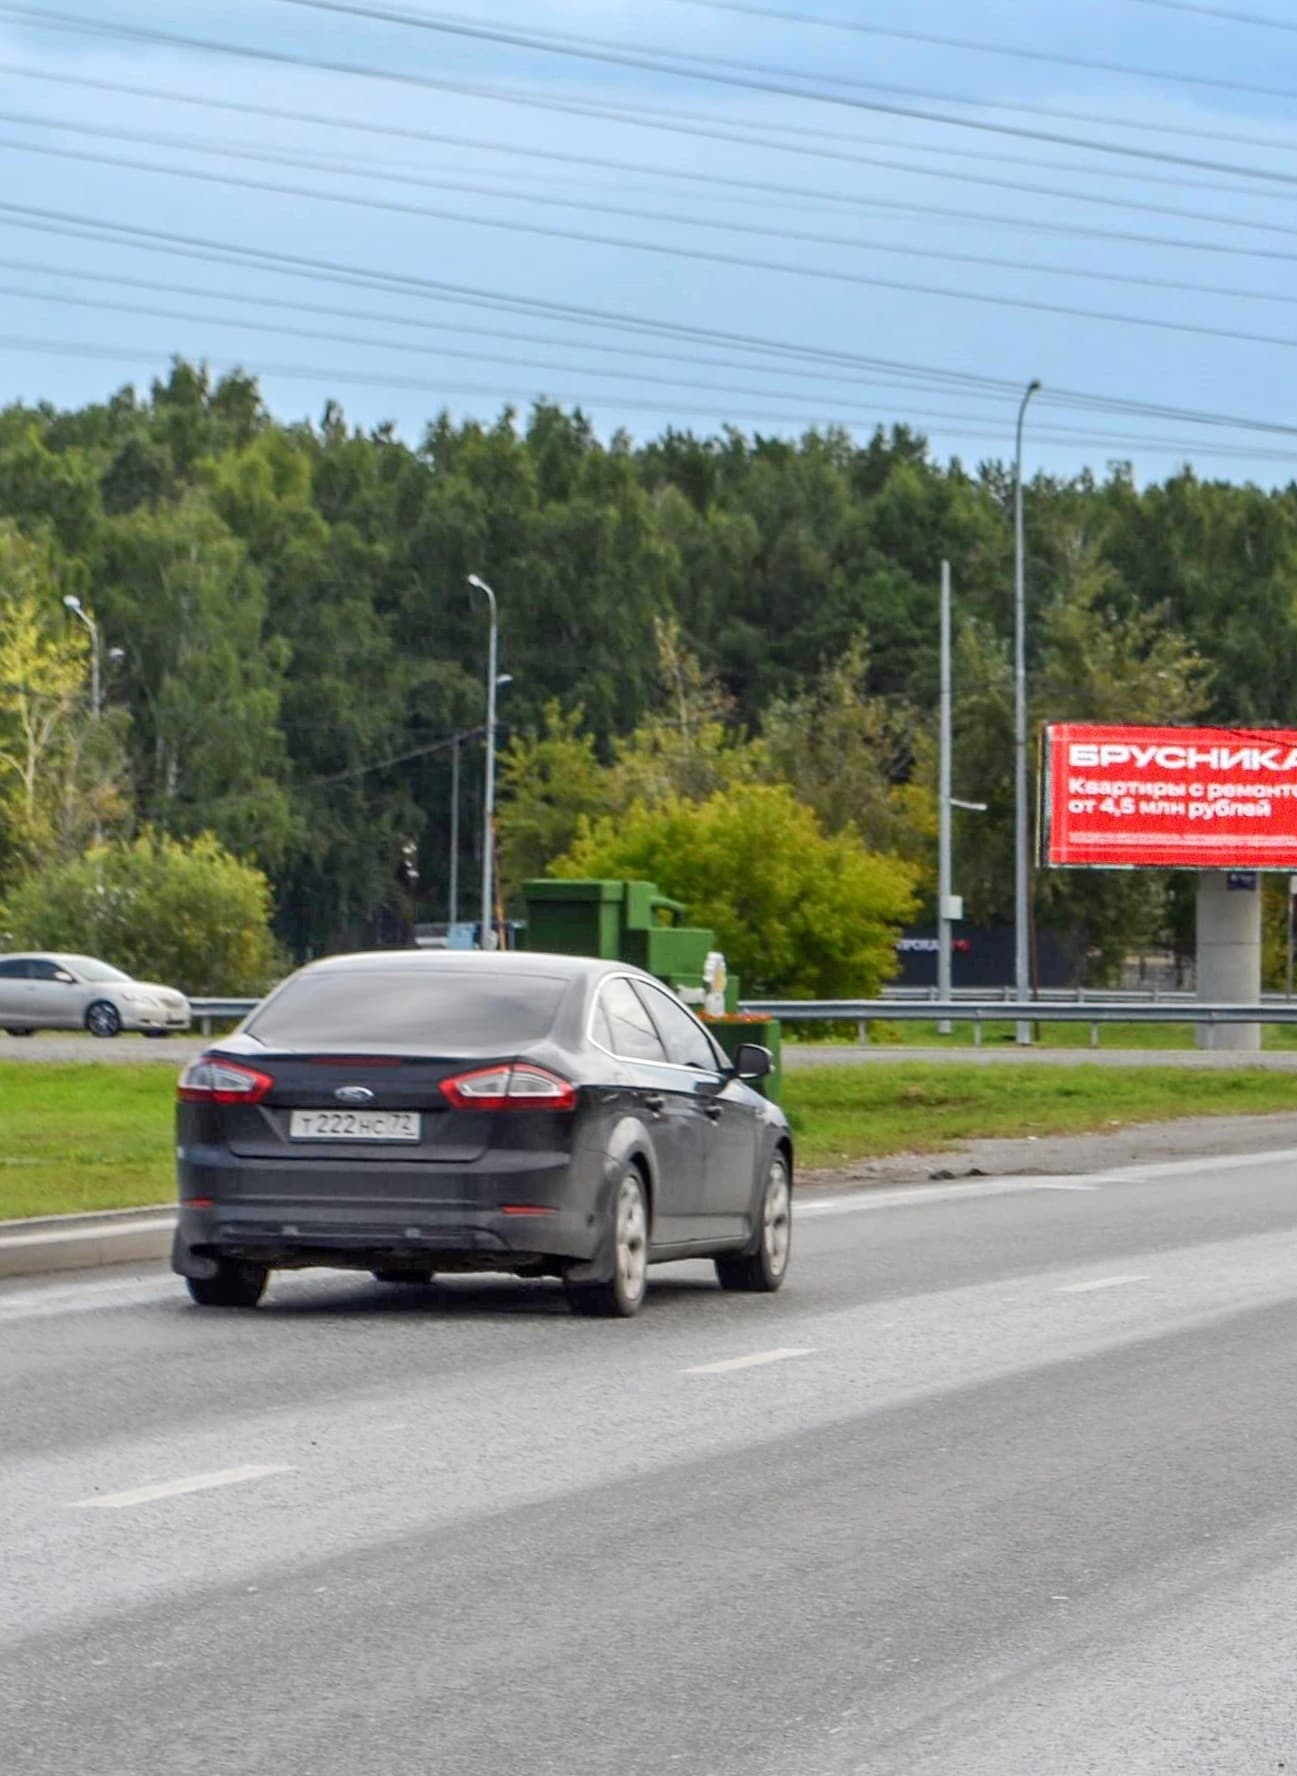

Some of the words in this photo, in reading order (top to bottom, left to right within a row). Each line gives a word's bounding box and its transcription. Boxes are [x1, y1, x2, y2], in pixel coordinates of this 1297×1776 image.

[1068, 778, 1187, 800] Квартиры
[1188, 783, 1204, 798] с
[1068, 799, 1097, 814] от
[1099, 797, 1136, 817] 4,5
[1138, 801, 1186, 815] млн
[1188, 799, 1272, 820] рублей
